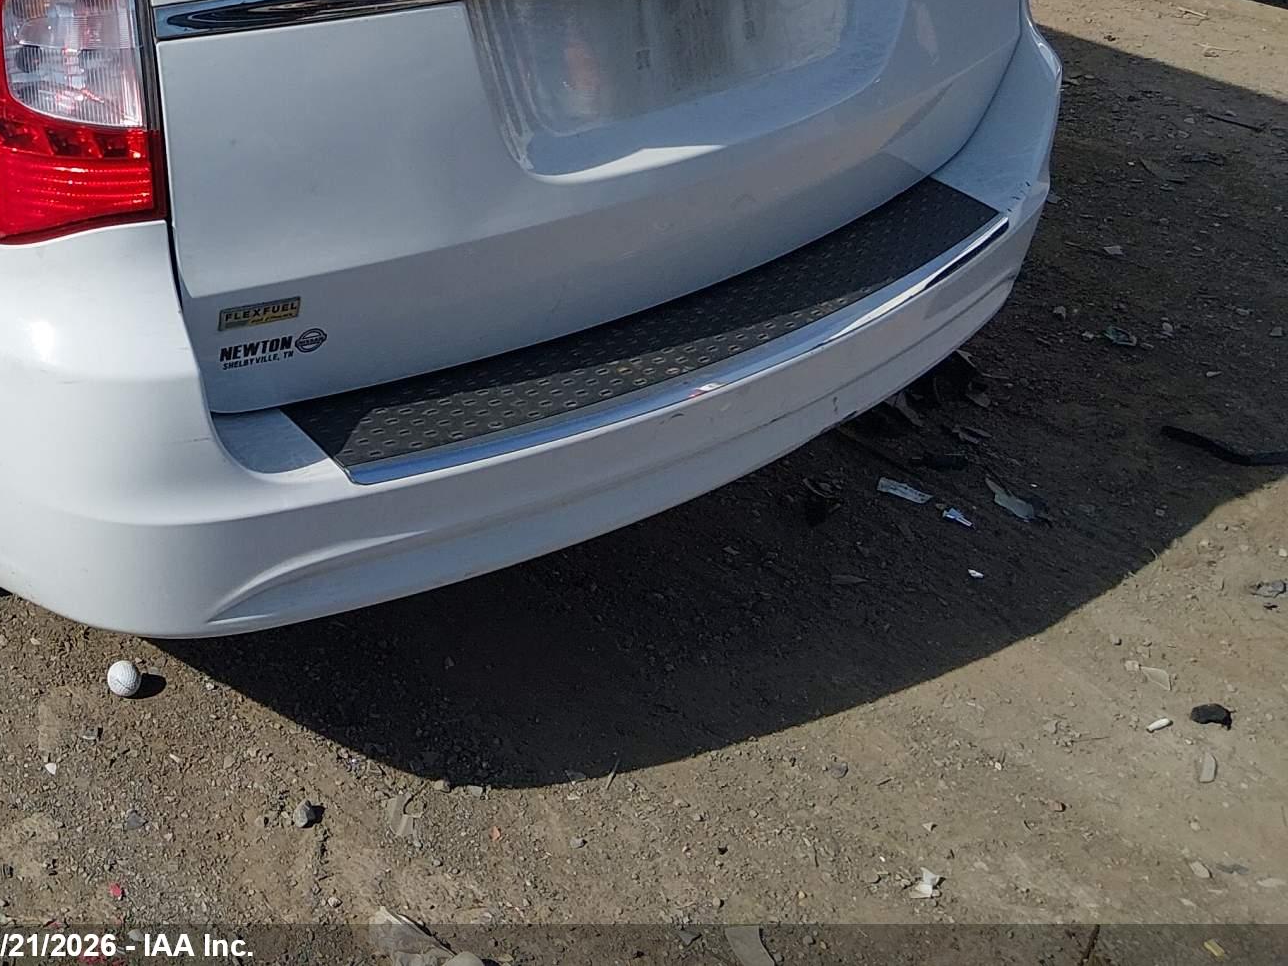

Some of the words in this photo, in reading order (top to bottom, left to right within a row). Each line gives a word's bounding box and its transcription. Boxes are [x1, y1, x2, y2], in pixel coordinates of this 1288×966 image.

[225, 302, 297, 322] FLEXFUEL
[220, 336, 293, 362] NEWTON
[223, 353, 280, 370] SHELBYVILLE,
